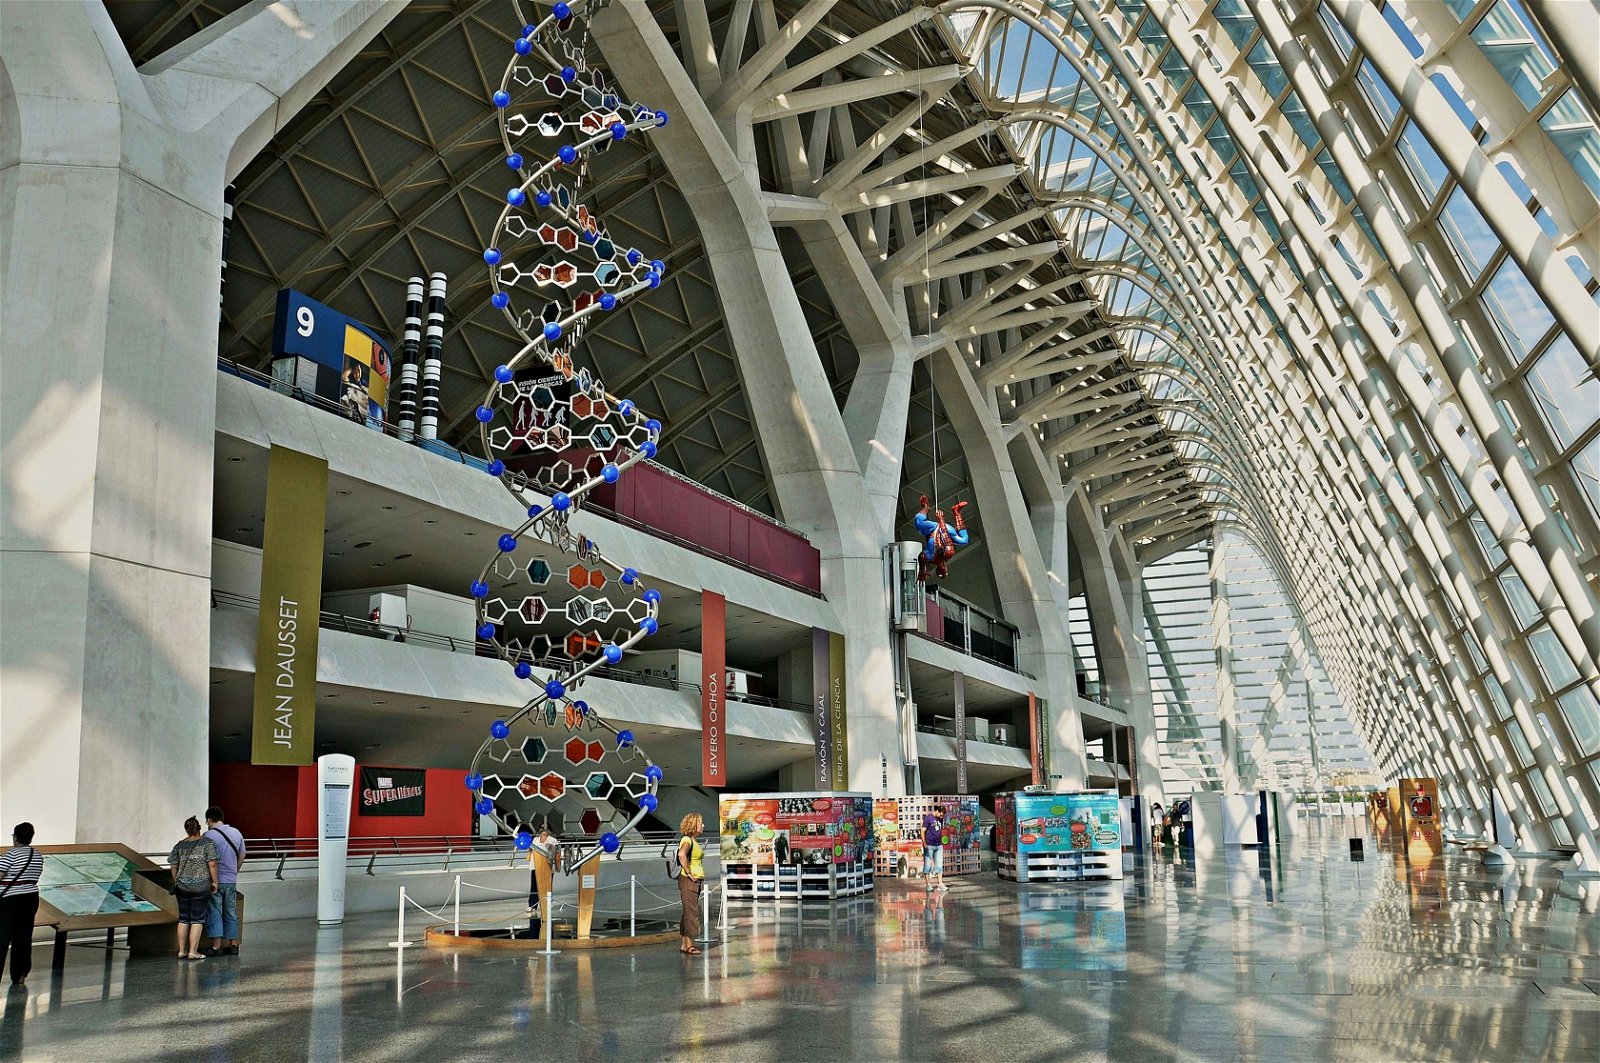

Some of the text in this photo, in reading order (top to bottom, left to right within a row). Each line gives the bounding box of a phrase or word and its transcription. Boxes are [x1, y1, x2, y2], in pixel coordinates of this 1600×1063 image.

[296, 306, 315, 337] 9
[537, 375, 564, 384] CIENTÍFIC
[274, 596, 298, 749] JEAN DAUSSET
[709, 672, 718, 776] SEVERO OCHOA
[818, 694, 827, 782] RAMÓN Y CAJAL
[835, 722, 842, 734] LA
[836, 738, 843, 751] DE
